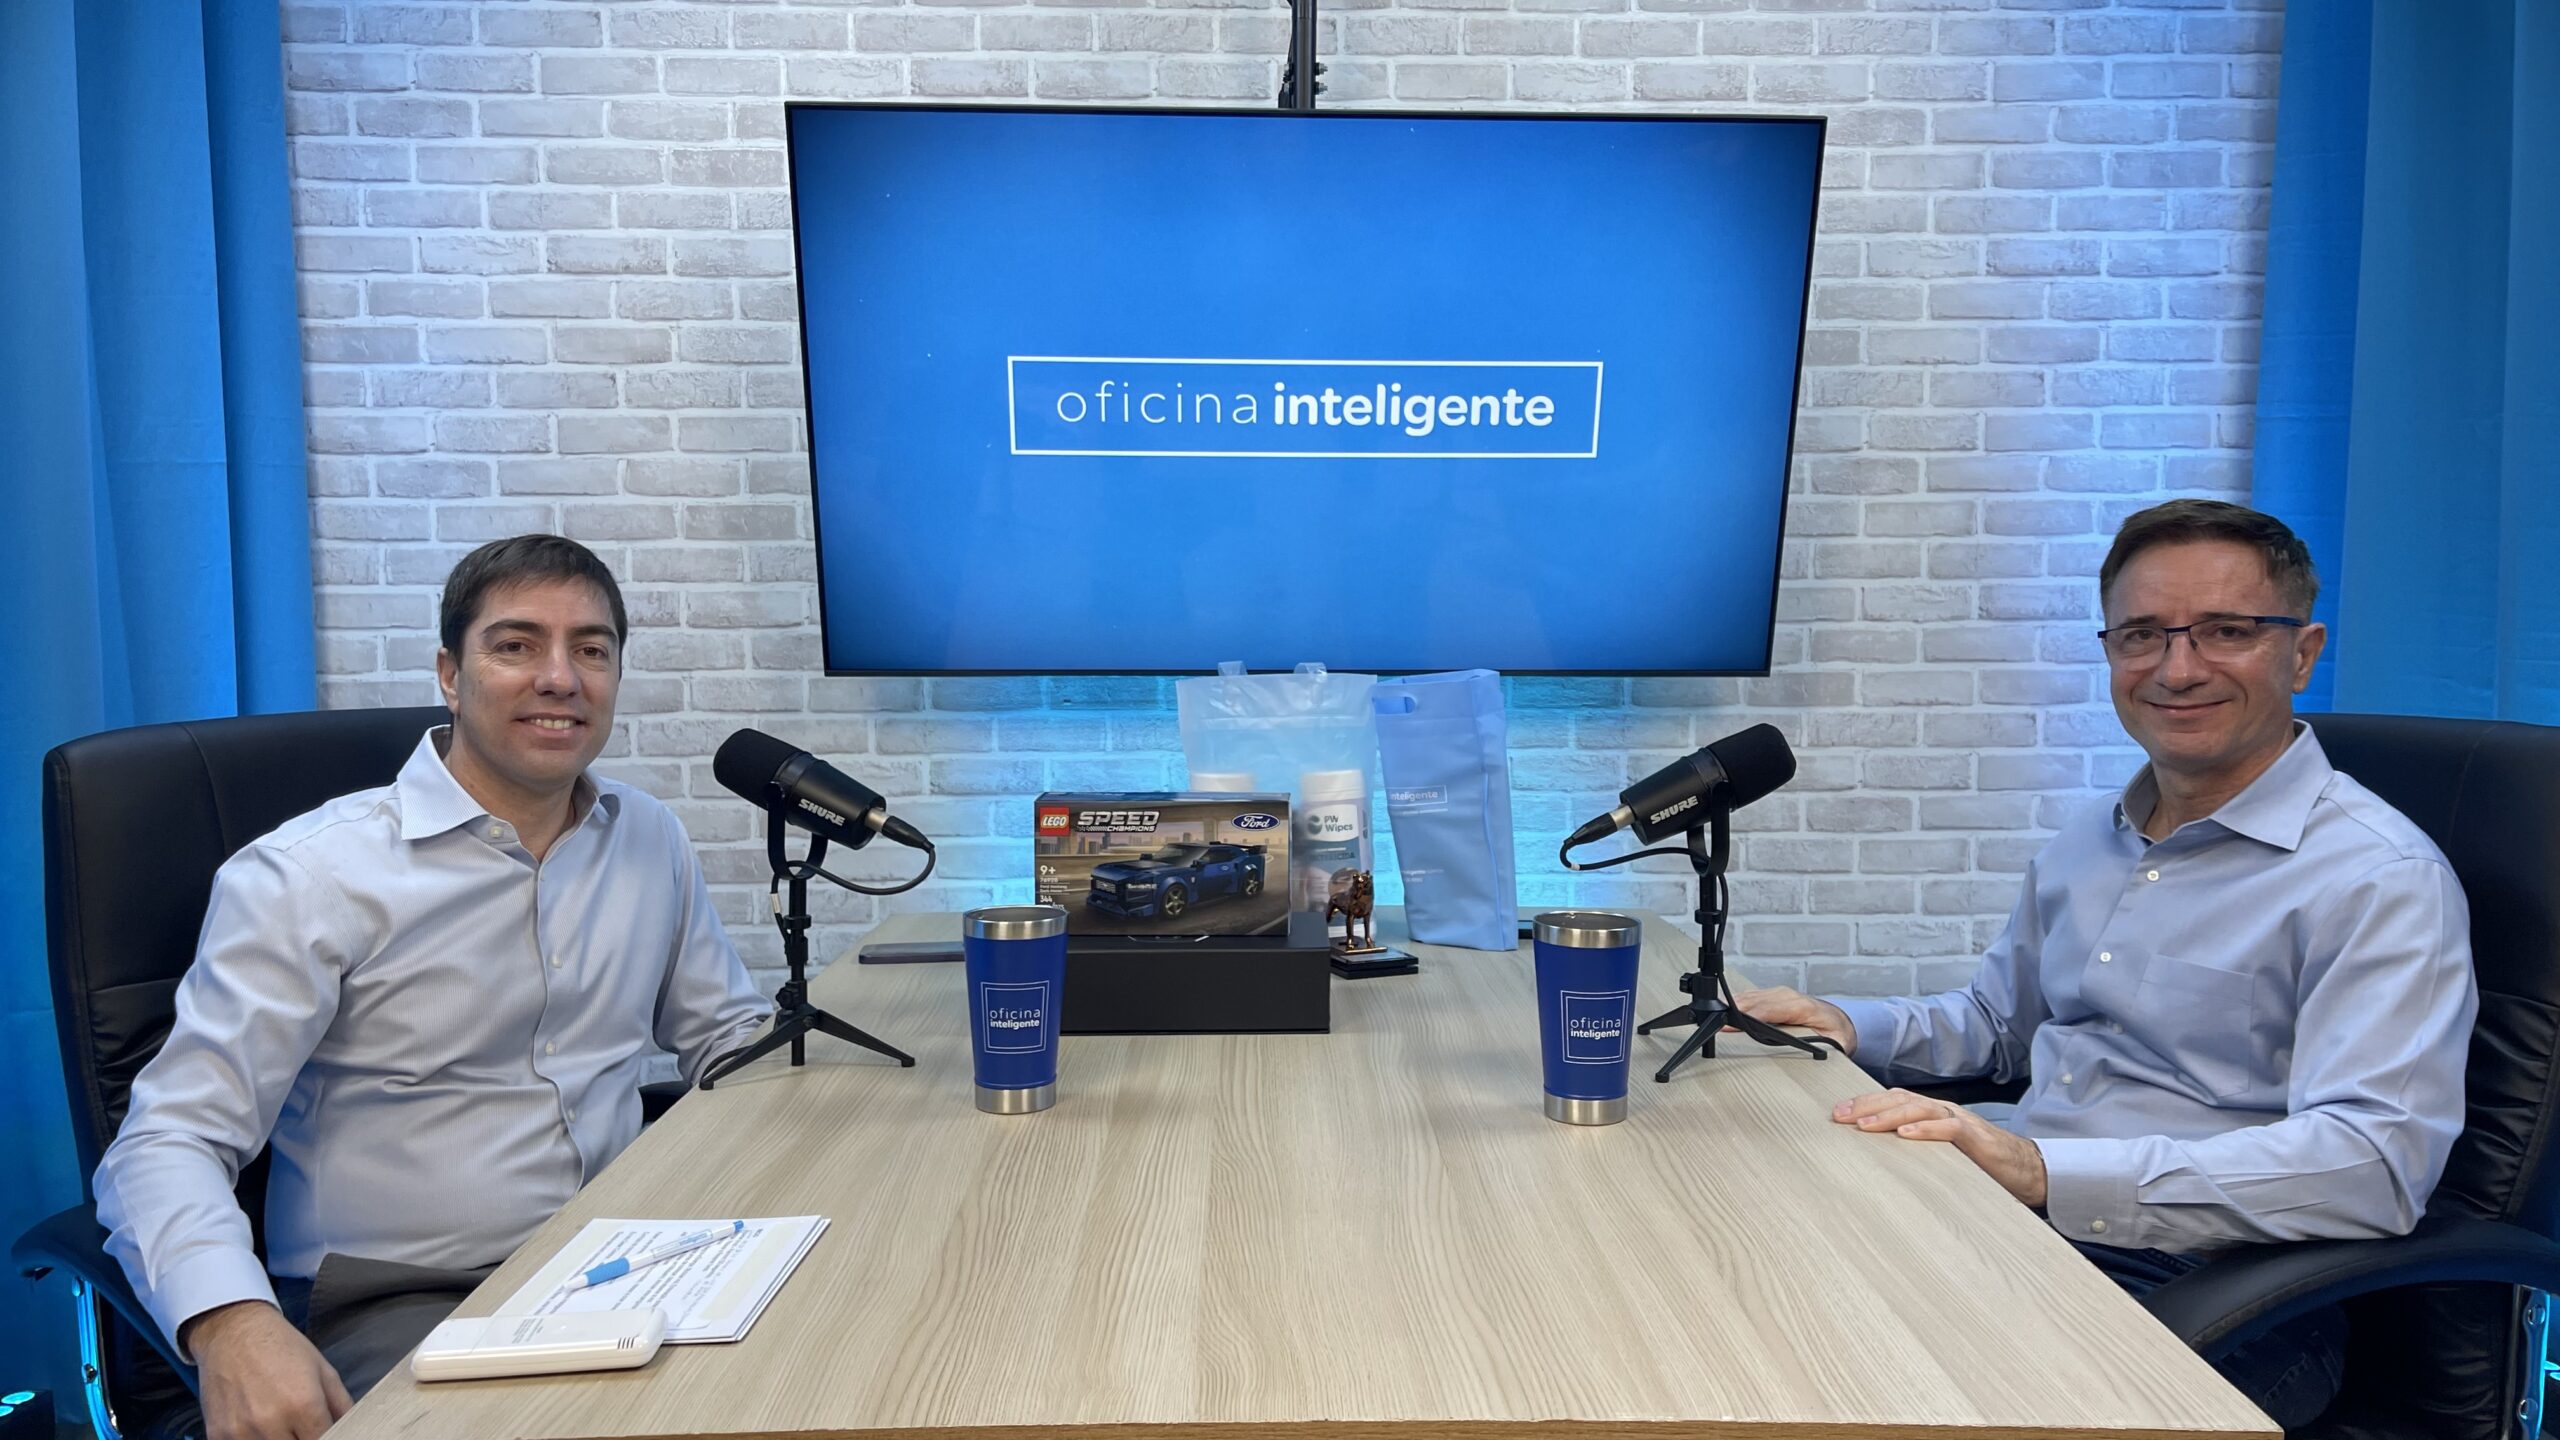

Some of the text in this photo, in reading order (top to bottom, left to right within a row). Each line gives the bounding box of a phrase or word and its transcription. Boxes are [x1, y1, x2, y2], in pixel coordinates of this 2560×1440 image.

[1057, 381, 1554, 436] oficina inteligente
[1391, 791, 1438, 801] nteligente
[798, 798, 846, 827] SHURE
[1650, 795, 1699, 825] SHURE
[1042, 815, 1067, 826] LEGO
[1077, 811, 1160, 826] SPEED
[1241, 815, 1271, 828] Ford
[1324, 815, 1339, 823] PW
[1325, 823, 1353, 832] Wipes
[1040, 865, 1056, 875] 9+
[1040, 895, 1053, 903] 344
[989, 1008, 1041, 1019] oficina
[990, 1019, 1040, 1030] inteligente
[1570, 1017, 1621, 1029] oficina
[1570, 1028, 1620, 1040] inteligente
